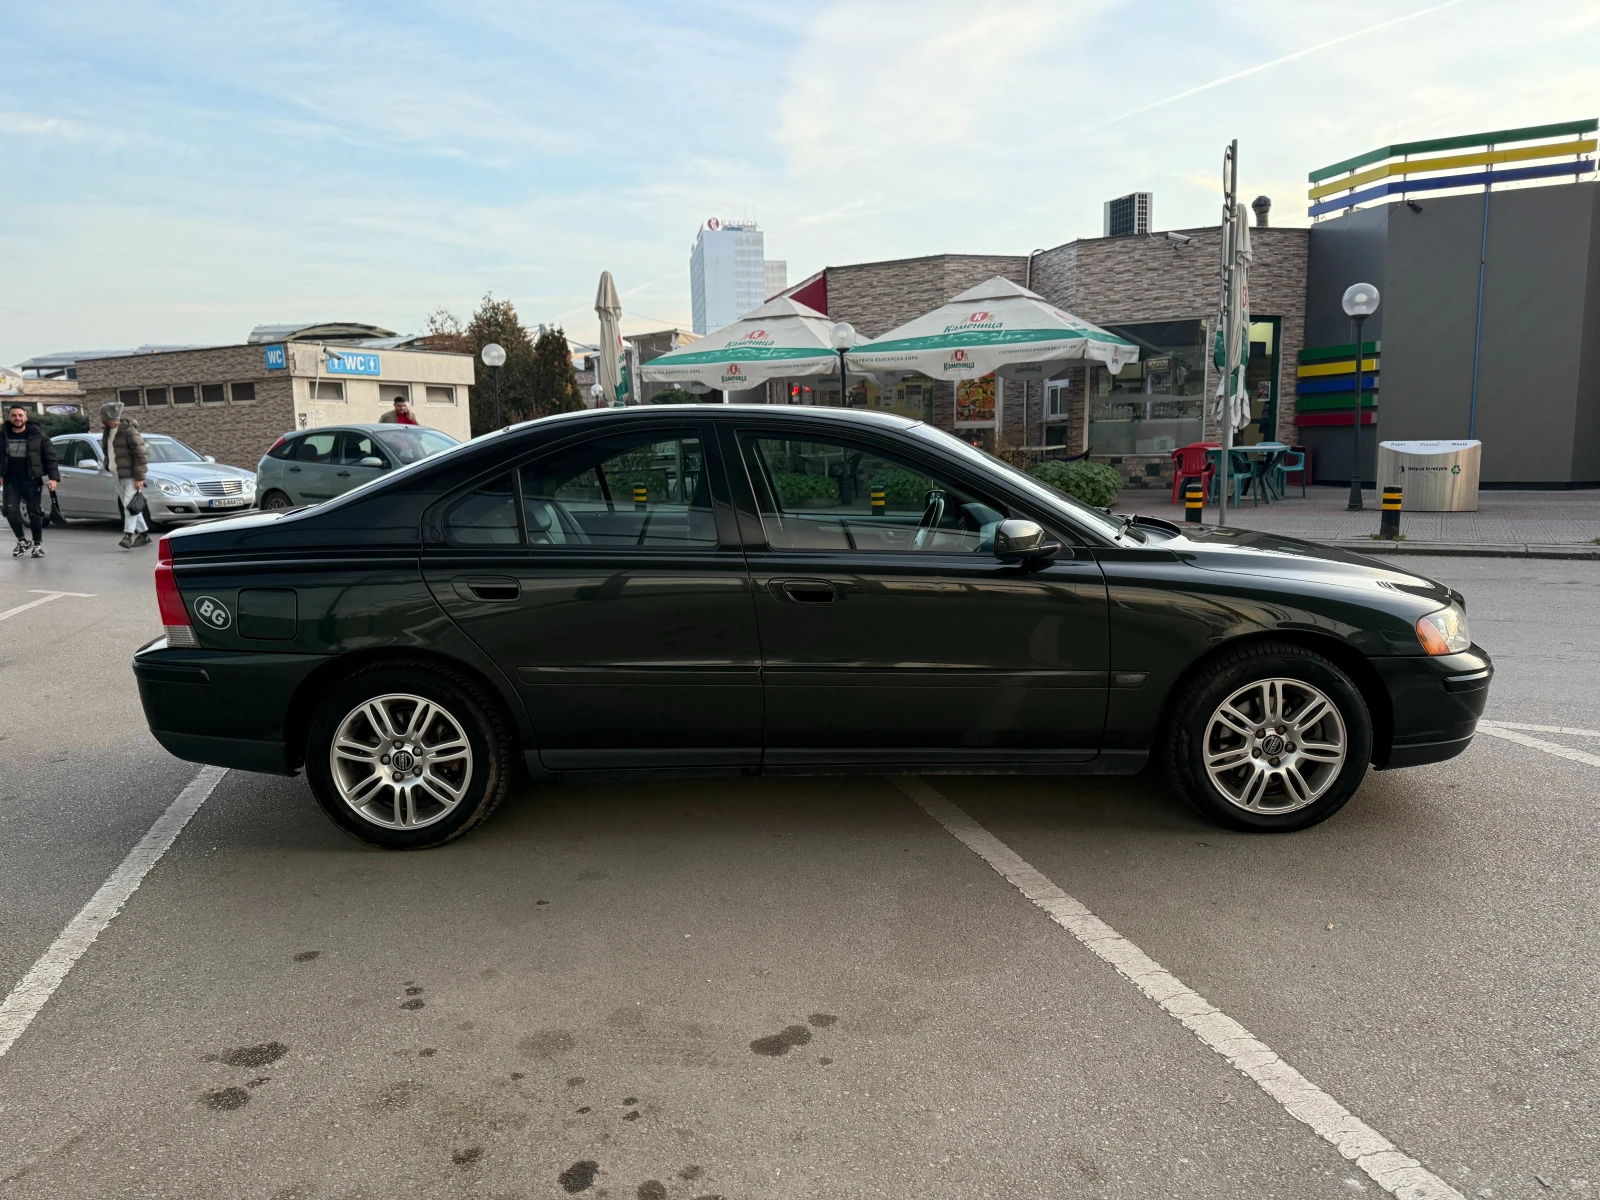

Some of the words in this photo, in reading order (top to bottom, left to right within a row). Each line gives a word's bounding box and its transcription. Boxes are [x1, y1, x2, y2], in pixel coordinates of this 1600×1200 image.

[943, 322, 1003, 333] Каменица
[267, 350, 282, 364] WC
[345, 355, 365, 371] WC
[943, 361, 975, 372] Каменица
[721, 375, 747, 383] Каменица
[199, 600, 226, 625] BG
